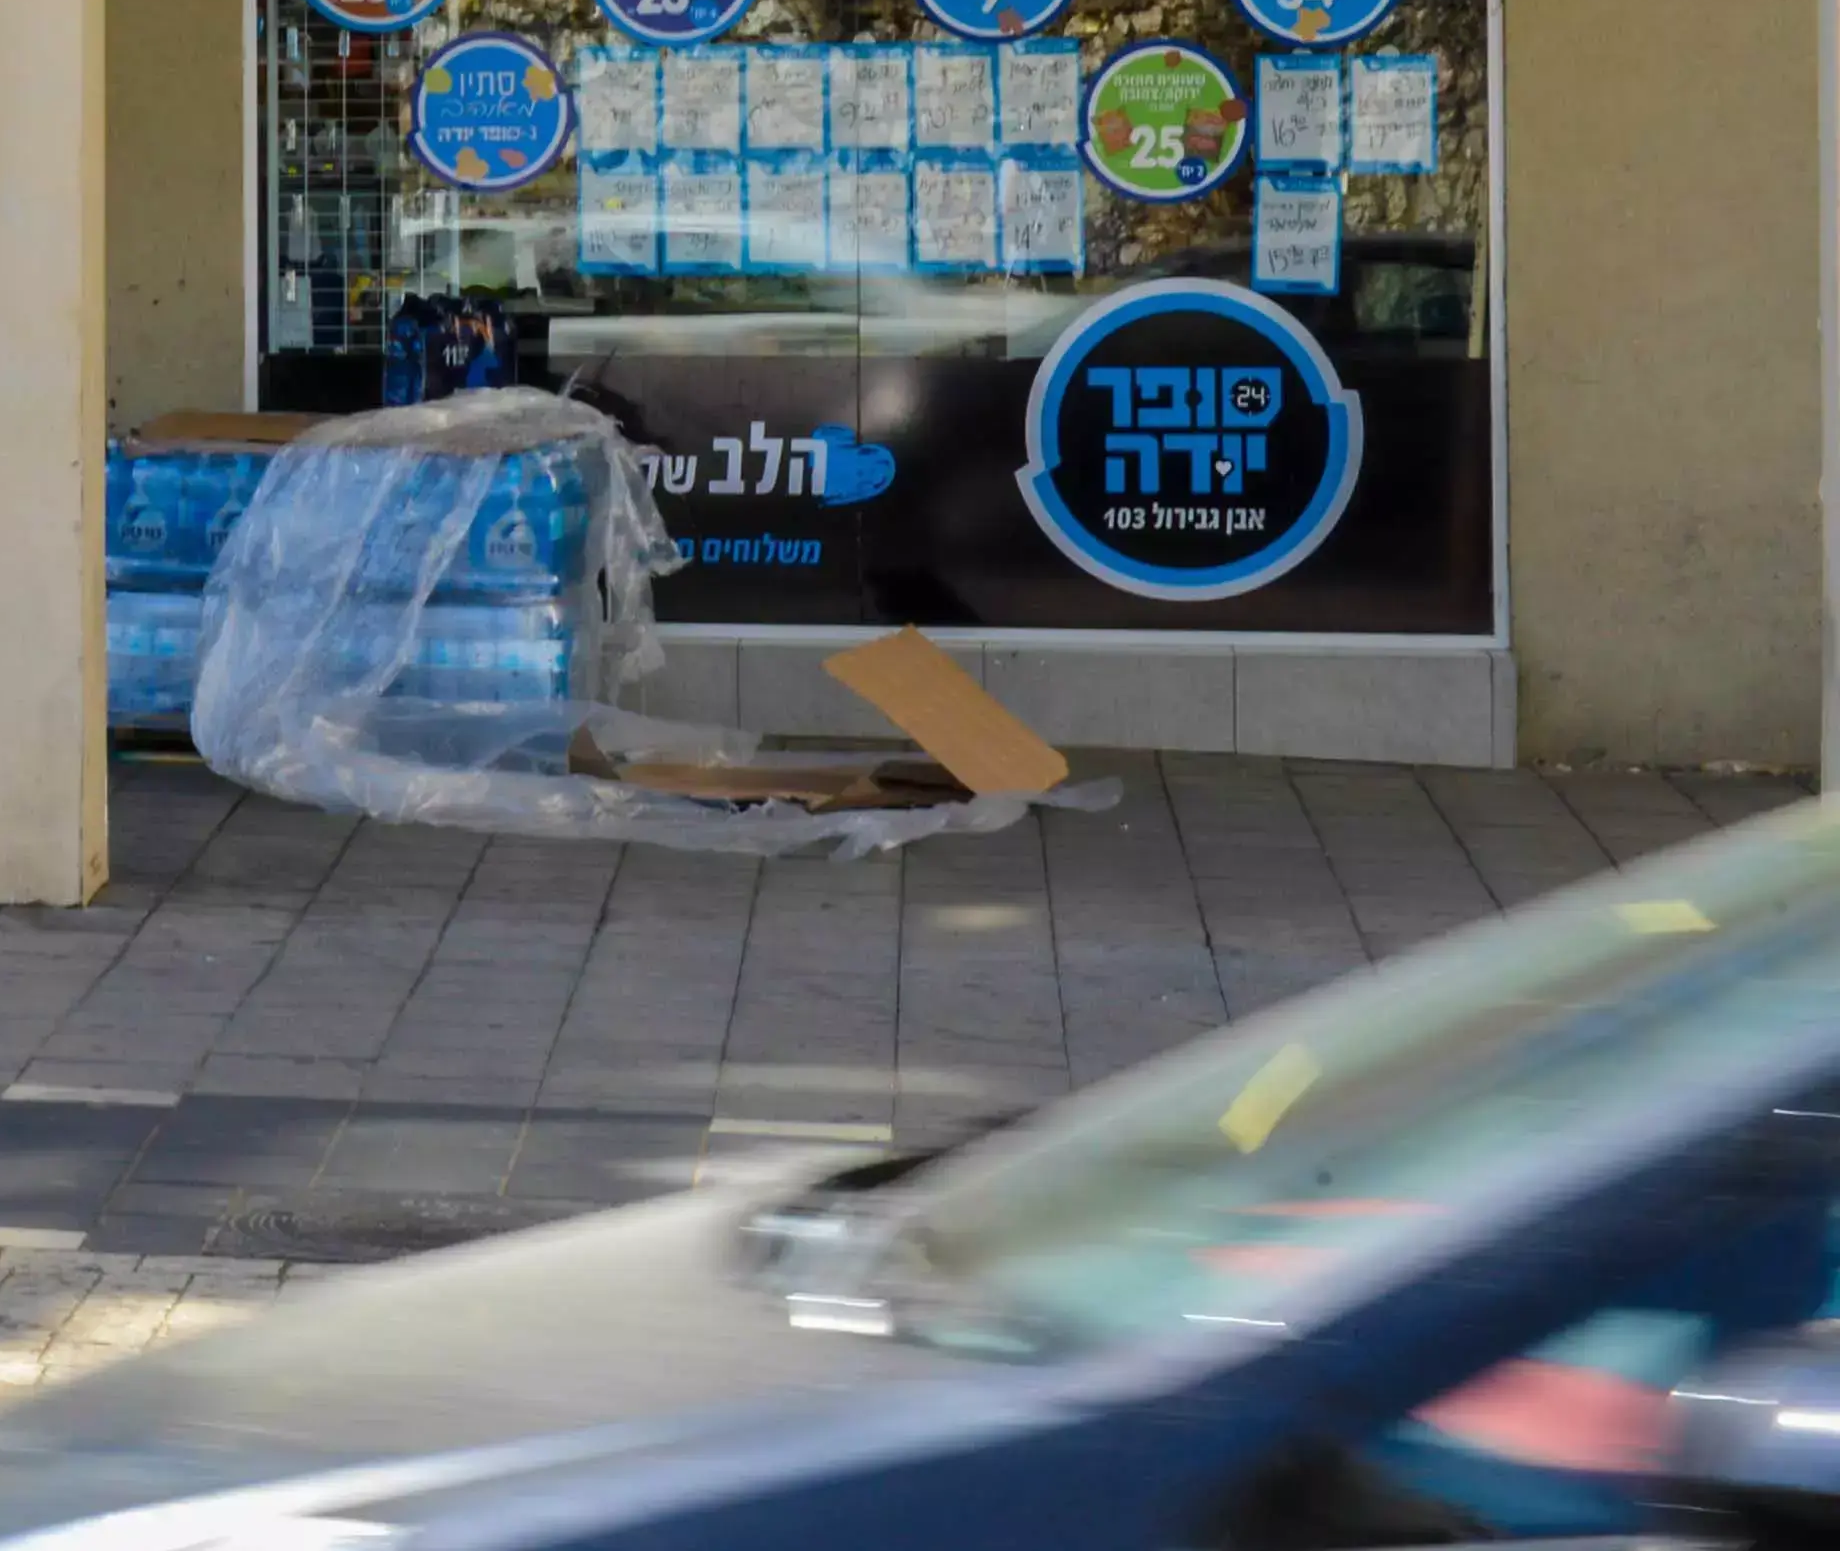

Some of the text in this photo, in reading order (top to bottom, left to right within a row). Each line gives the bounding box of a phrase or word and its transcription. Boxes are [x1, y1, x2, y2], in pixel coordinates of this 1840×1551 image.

[438, 126, 474, 142] יודה
[1129, 124, 1185, 169] 25
[1087, 366, 1283, 429] סופר
[1236, 384, 1266, 408] 24
[708, 420, 828, 496] הלב
[1104, 433, 1267, 495] יודה
[1103, 502, 1266, 535] אבן גבירול 103
[701, 532, 822, 565] משלוחים
